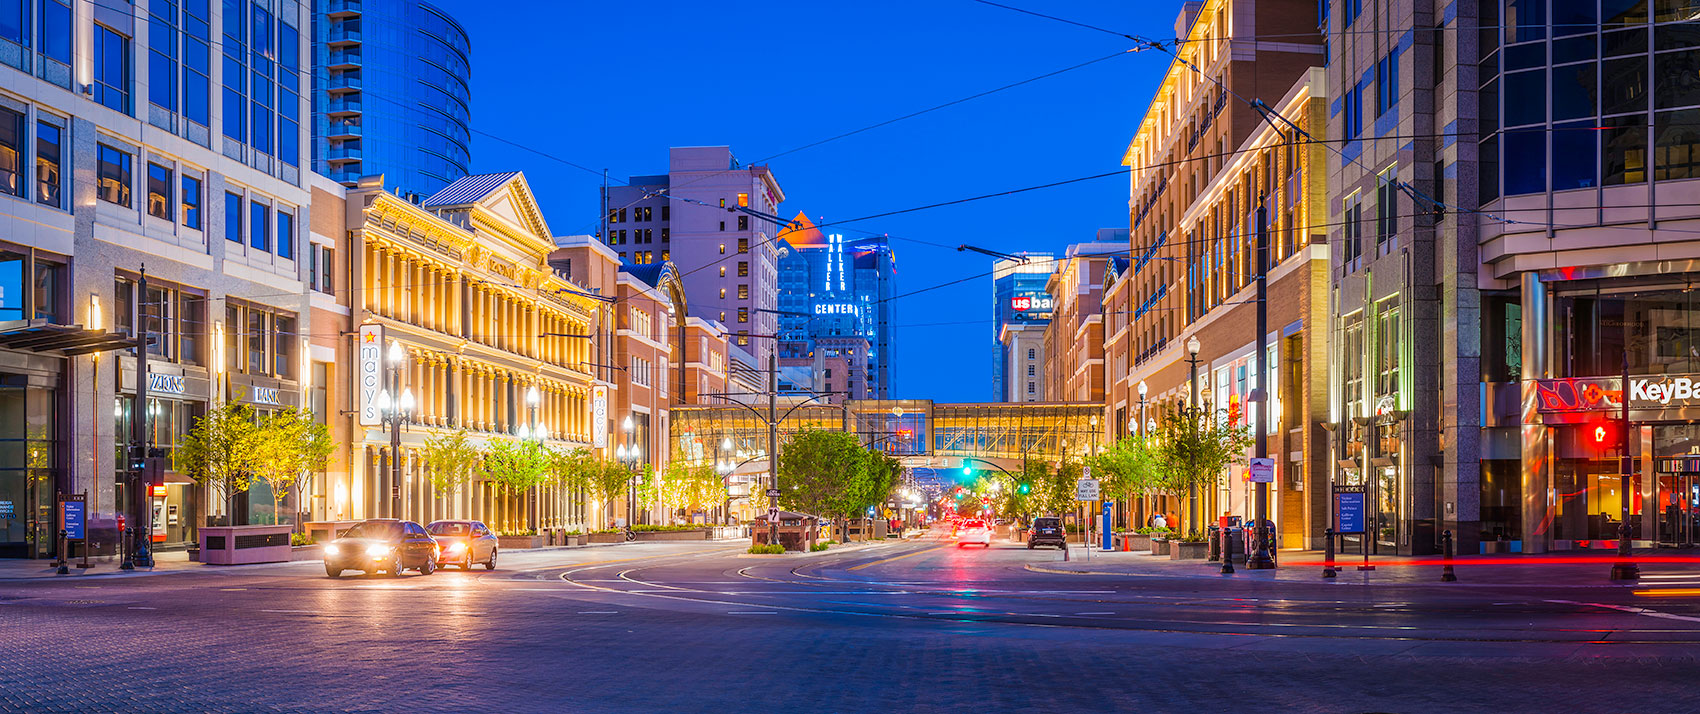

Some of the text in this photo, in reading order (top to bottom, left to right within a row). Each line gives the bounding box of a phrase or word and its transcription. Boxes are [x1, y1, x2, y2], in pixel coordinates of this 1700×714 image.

[825, 234, 835, 291] WALKER
[836, 234, 846, 291] WALKER
[815, 304, 853, 314] CENTER
[149, 373, 185, 393] ZIONS
[254, 386, 281, 405] BANK
[362, 346, 378, 419] macys
[594, 399, 606, 446] macys
